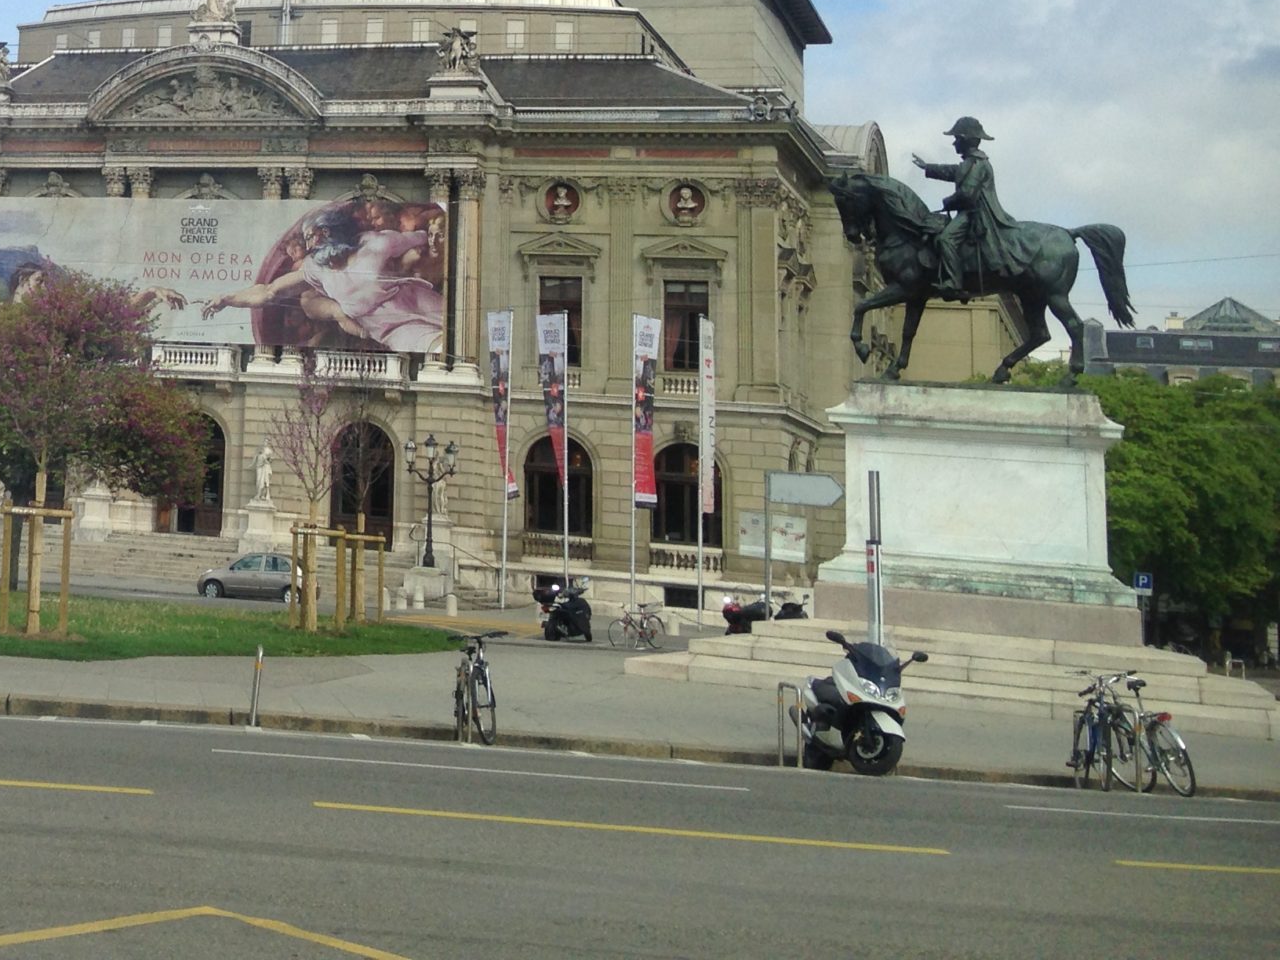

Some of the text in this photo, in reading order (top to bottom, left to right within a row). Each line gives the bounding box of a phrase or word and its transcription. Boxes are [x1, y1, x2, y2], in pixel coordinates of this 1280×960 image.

[180, 217, 219, 228] GRAND
[143, 251, 182, 264] MON
[142, 267, 253, 281] MON AMOUR
[1138, 575, 1148, 587] P
